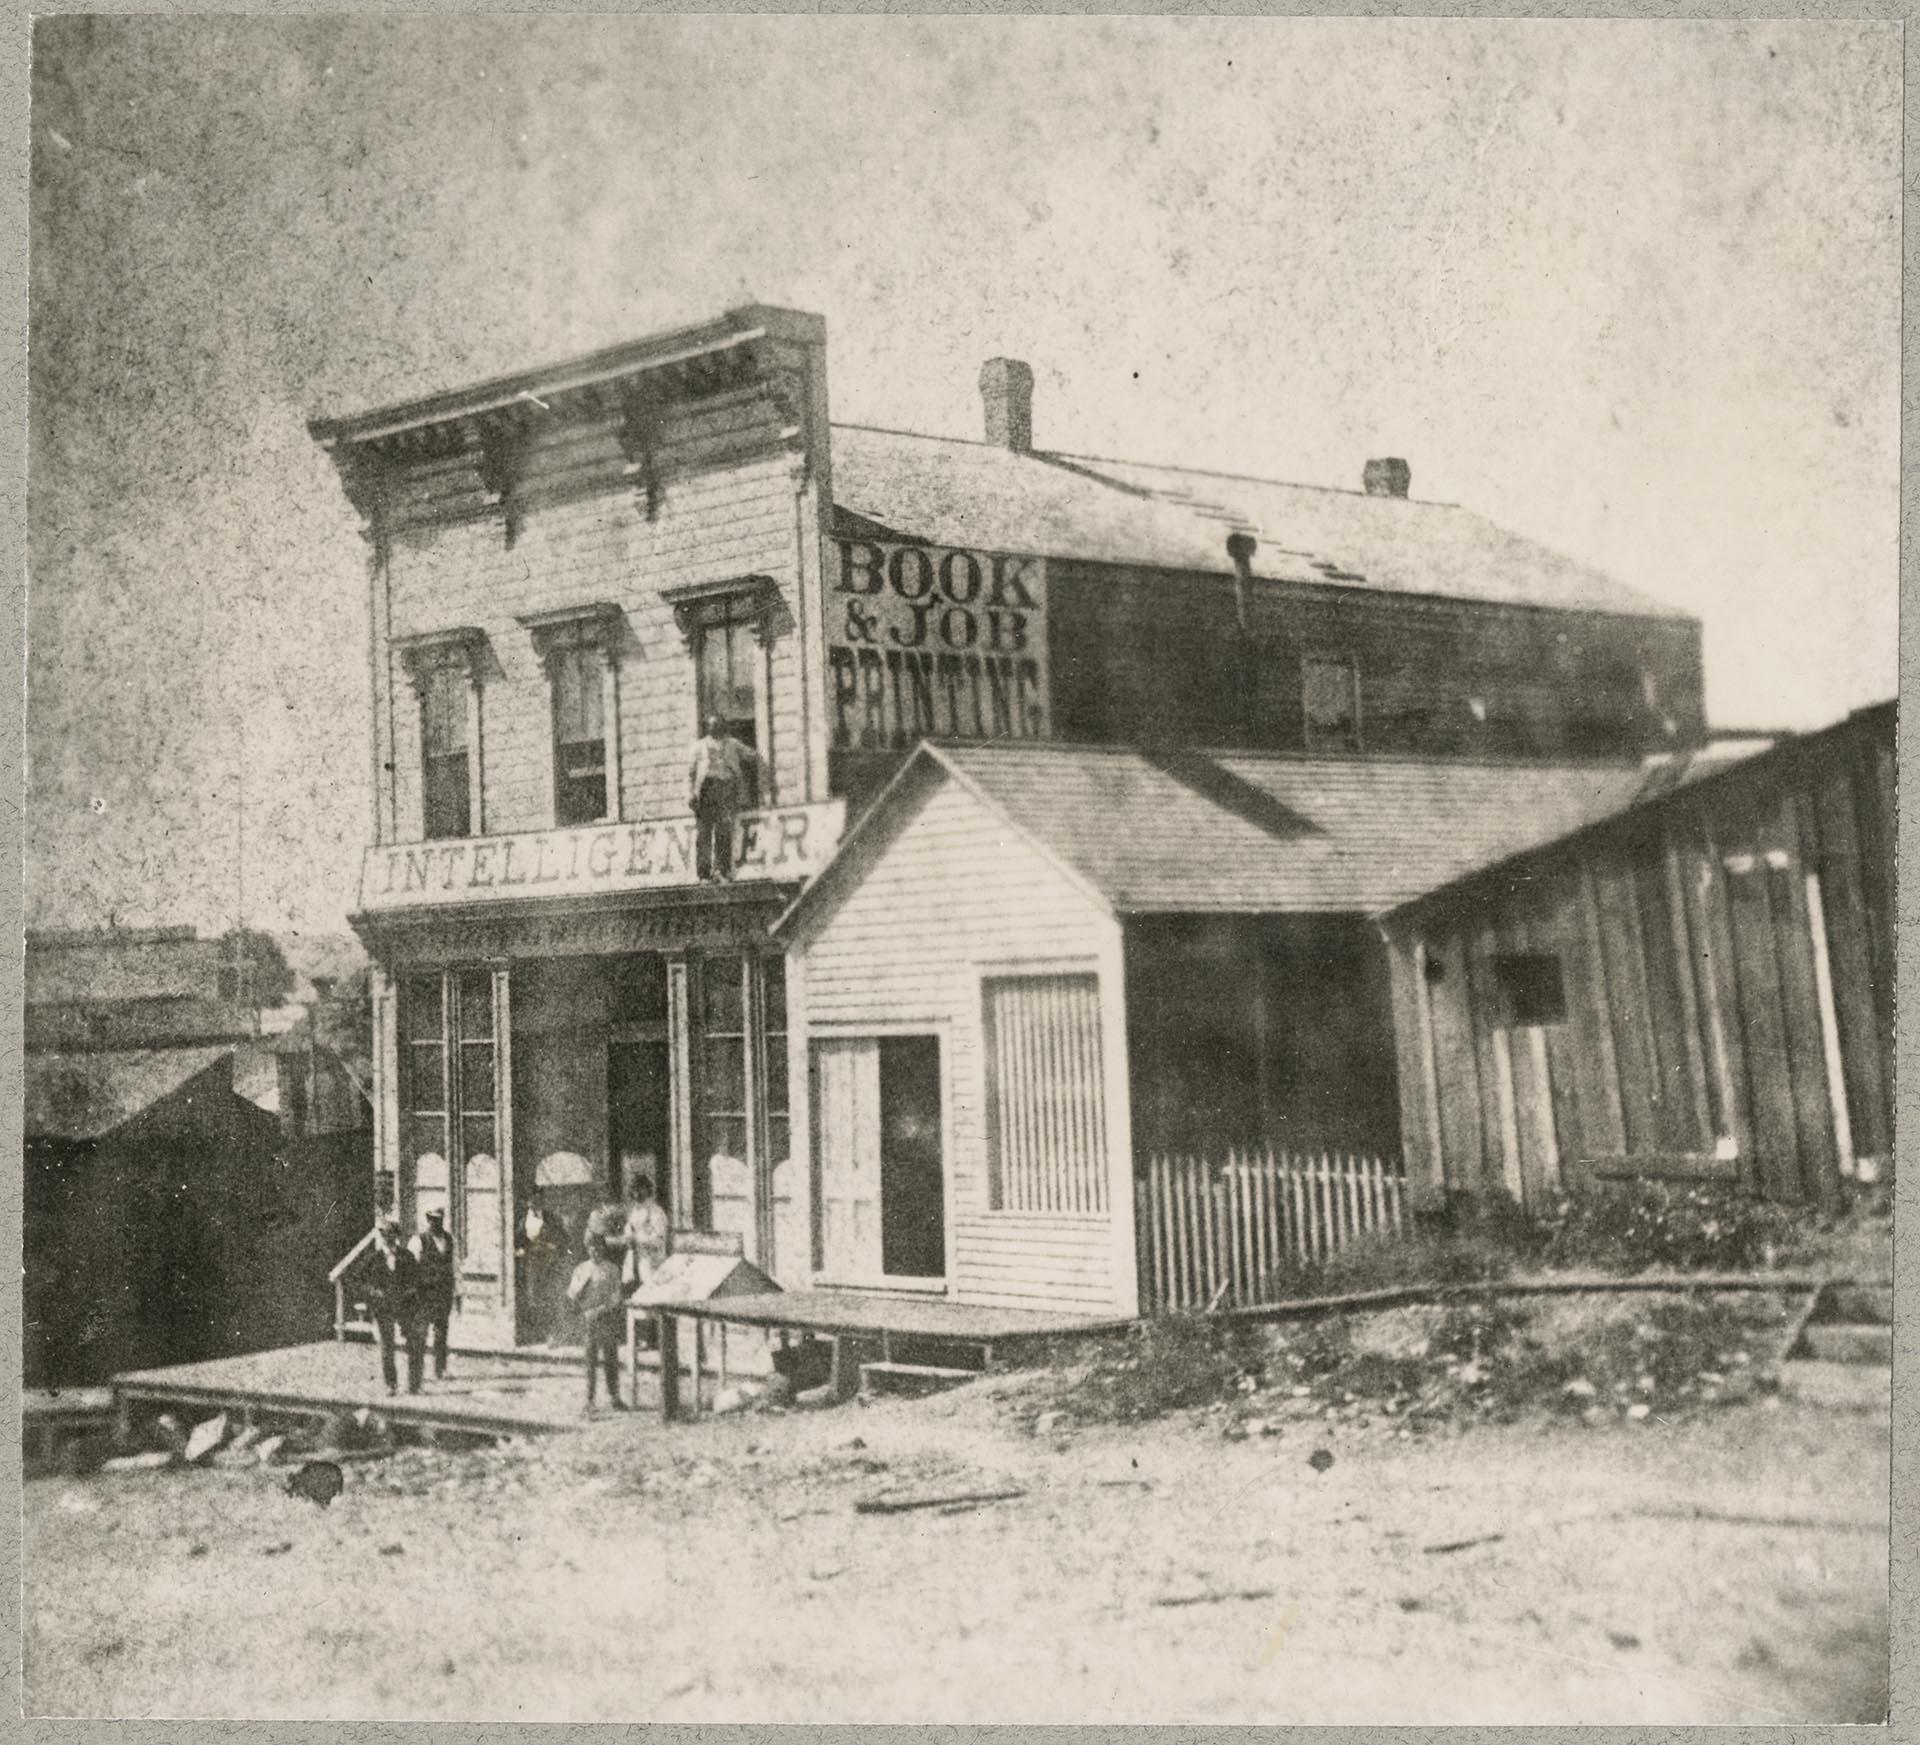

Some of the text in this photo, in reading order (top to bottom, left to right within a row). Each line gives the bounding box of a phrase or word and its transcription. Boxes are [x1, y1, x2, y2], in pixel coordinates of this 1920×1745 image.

[832, 540, 1040, 610] BOOK
[845, 593, 1028, 650] & JOB
[374, 811, 809, 894] INTELLIGENER
